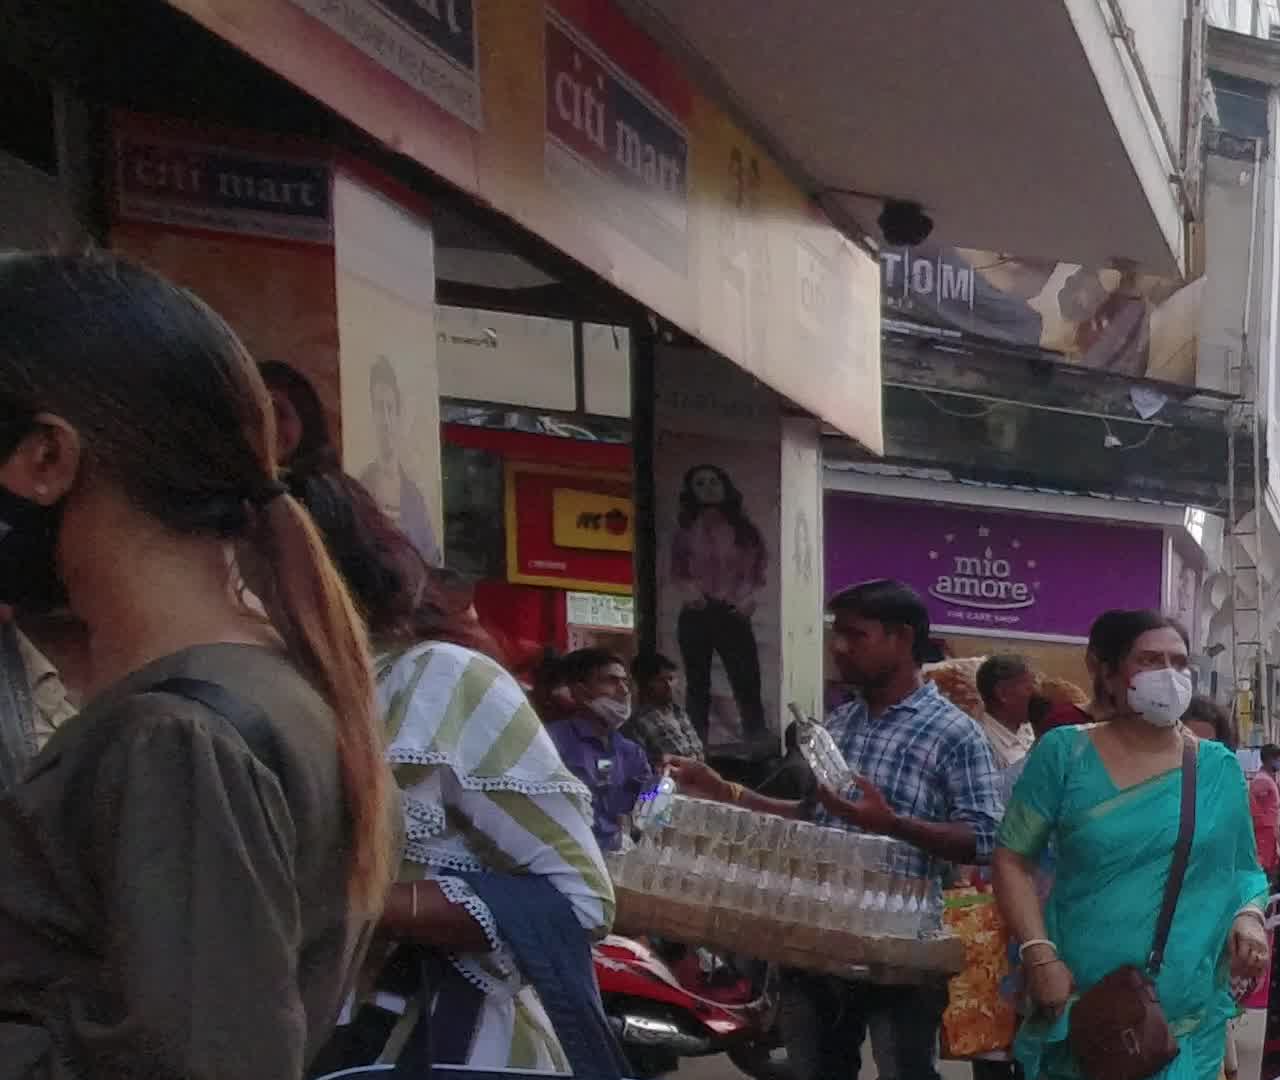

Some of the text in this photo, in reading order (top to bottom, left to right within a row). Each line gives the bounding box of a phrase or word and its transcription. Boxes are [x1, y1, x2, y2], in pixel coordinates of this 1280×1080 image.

[554, 52, 606, 146] citi
[615, 119, 682, 193] mart
[216, 171, 315, 208] mart
[953, 549, 1010, 578] mio
[935, 575, 1028, 601] amore
